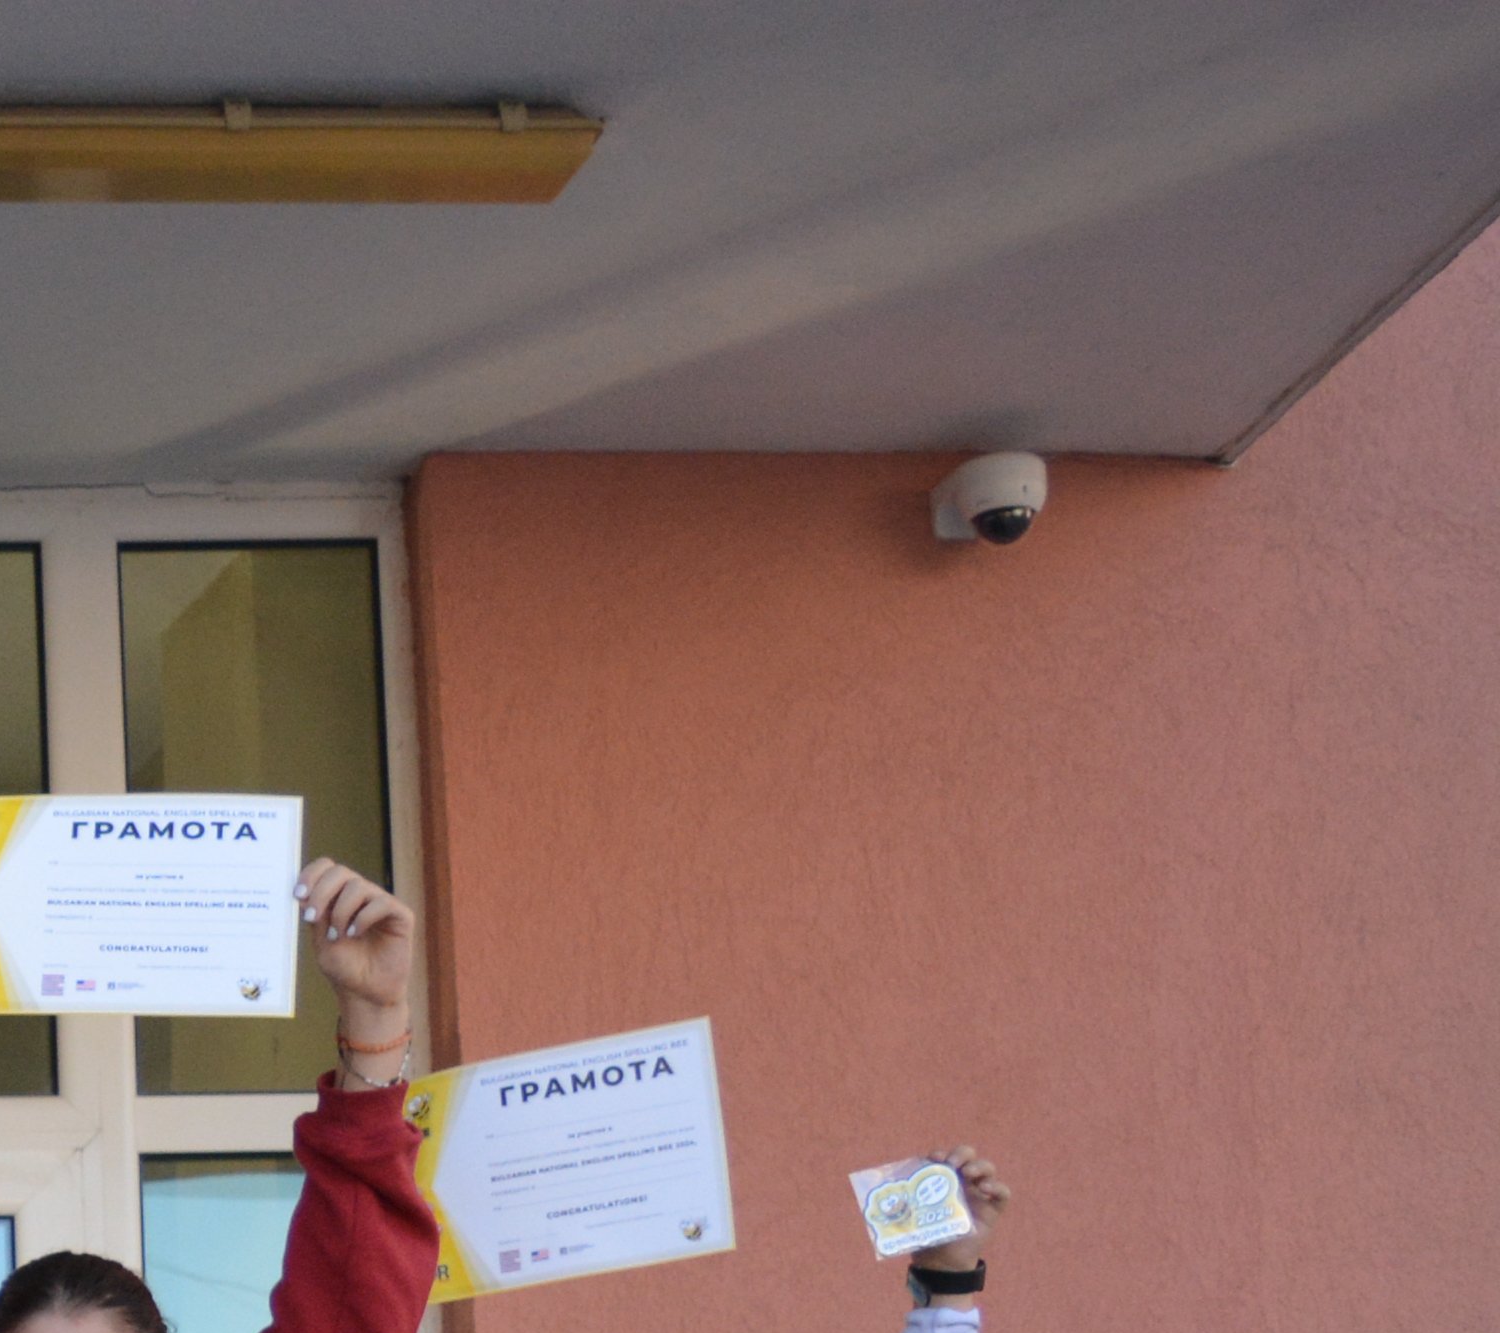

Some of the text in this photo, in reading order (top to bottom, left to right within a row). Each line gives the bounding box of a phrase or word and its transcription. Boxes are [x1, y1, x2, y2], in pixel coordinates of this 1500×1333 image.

[71, 821, 257, 841] ГРАМОТА
[100, 944, 208, 953] CONGRATULATIONS!
[499, 1056, 674, 1106] ГРАМОТА
